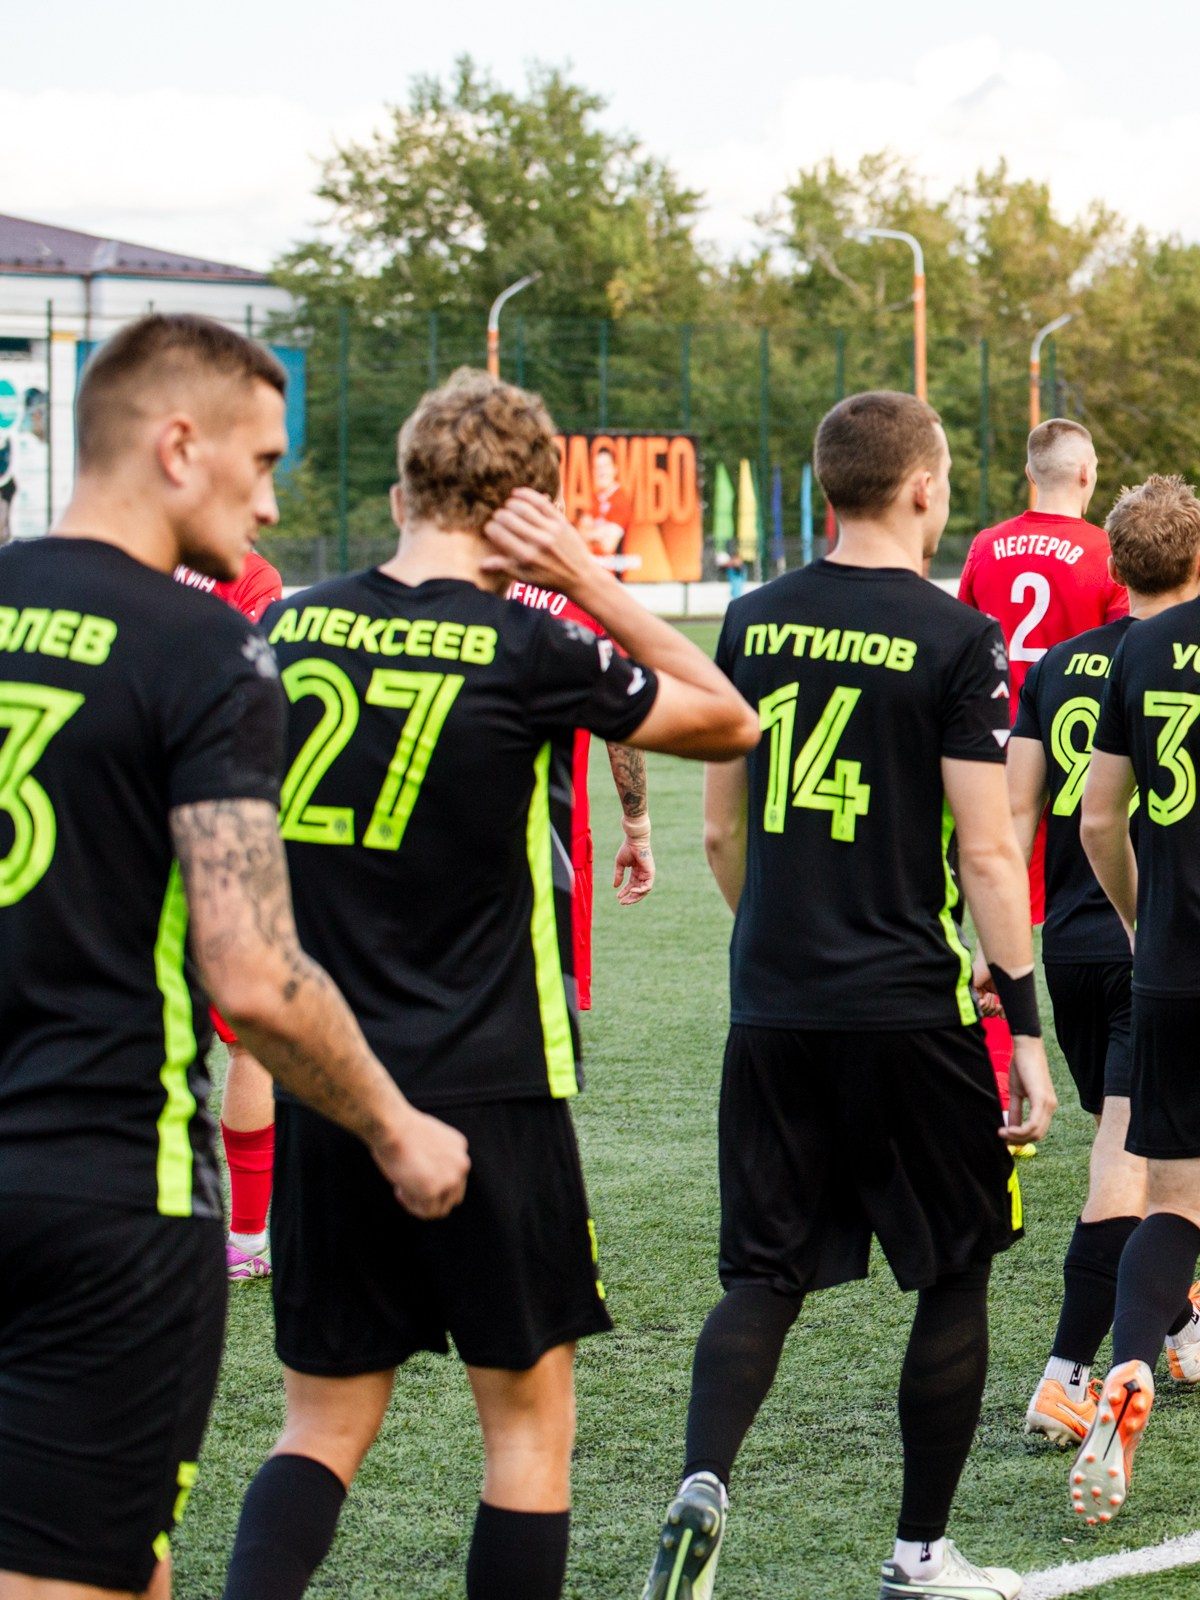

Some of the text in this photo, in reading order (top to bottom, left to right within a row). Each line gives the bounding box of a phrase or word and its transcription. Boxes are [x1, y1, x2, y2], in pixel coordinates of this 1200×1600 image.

[993, 535, 1084, 565] НЕСТЕРОВ
[268, 606, 498, 665] АЛЕКСЕЕВ
[1009, 571, 1050, 662] 2
[744, 624, 918, 672] ПУТИЛОВ
[1064, 653, 1113, 678] ЛО
[280, 657, 465, 850] 27
[757, 681, 871, 843] 14
